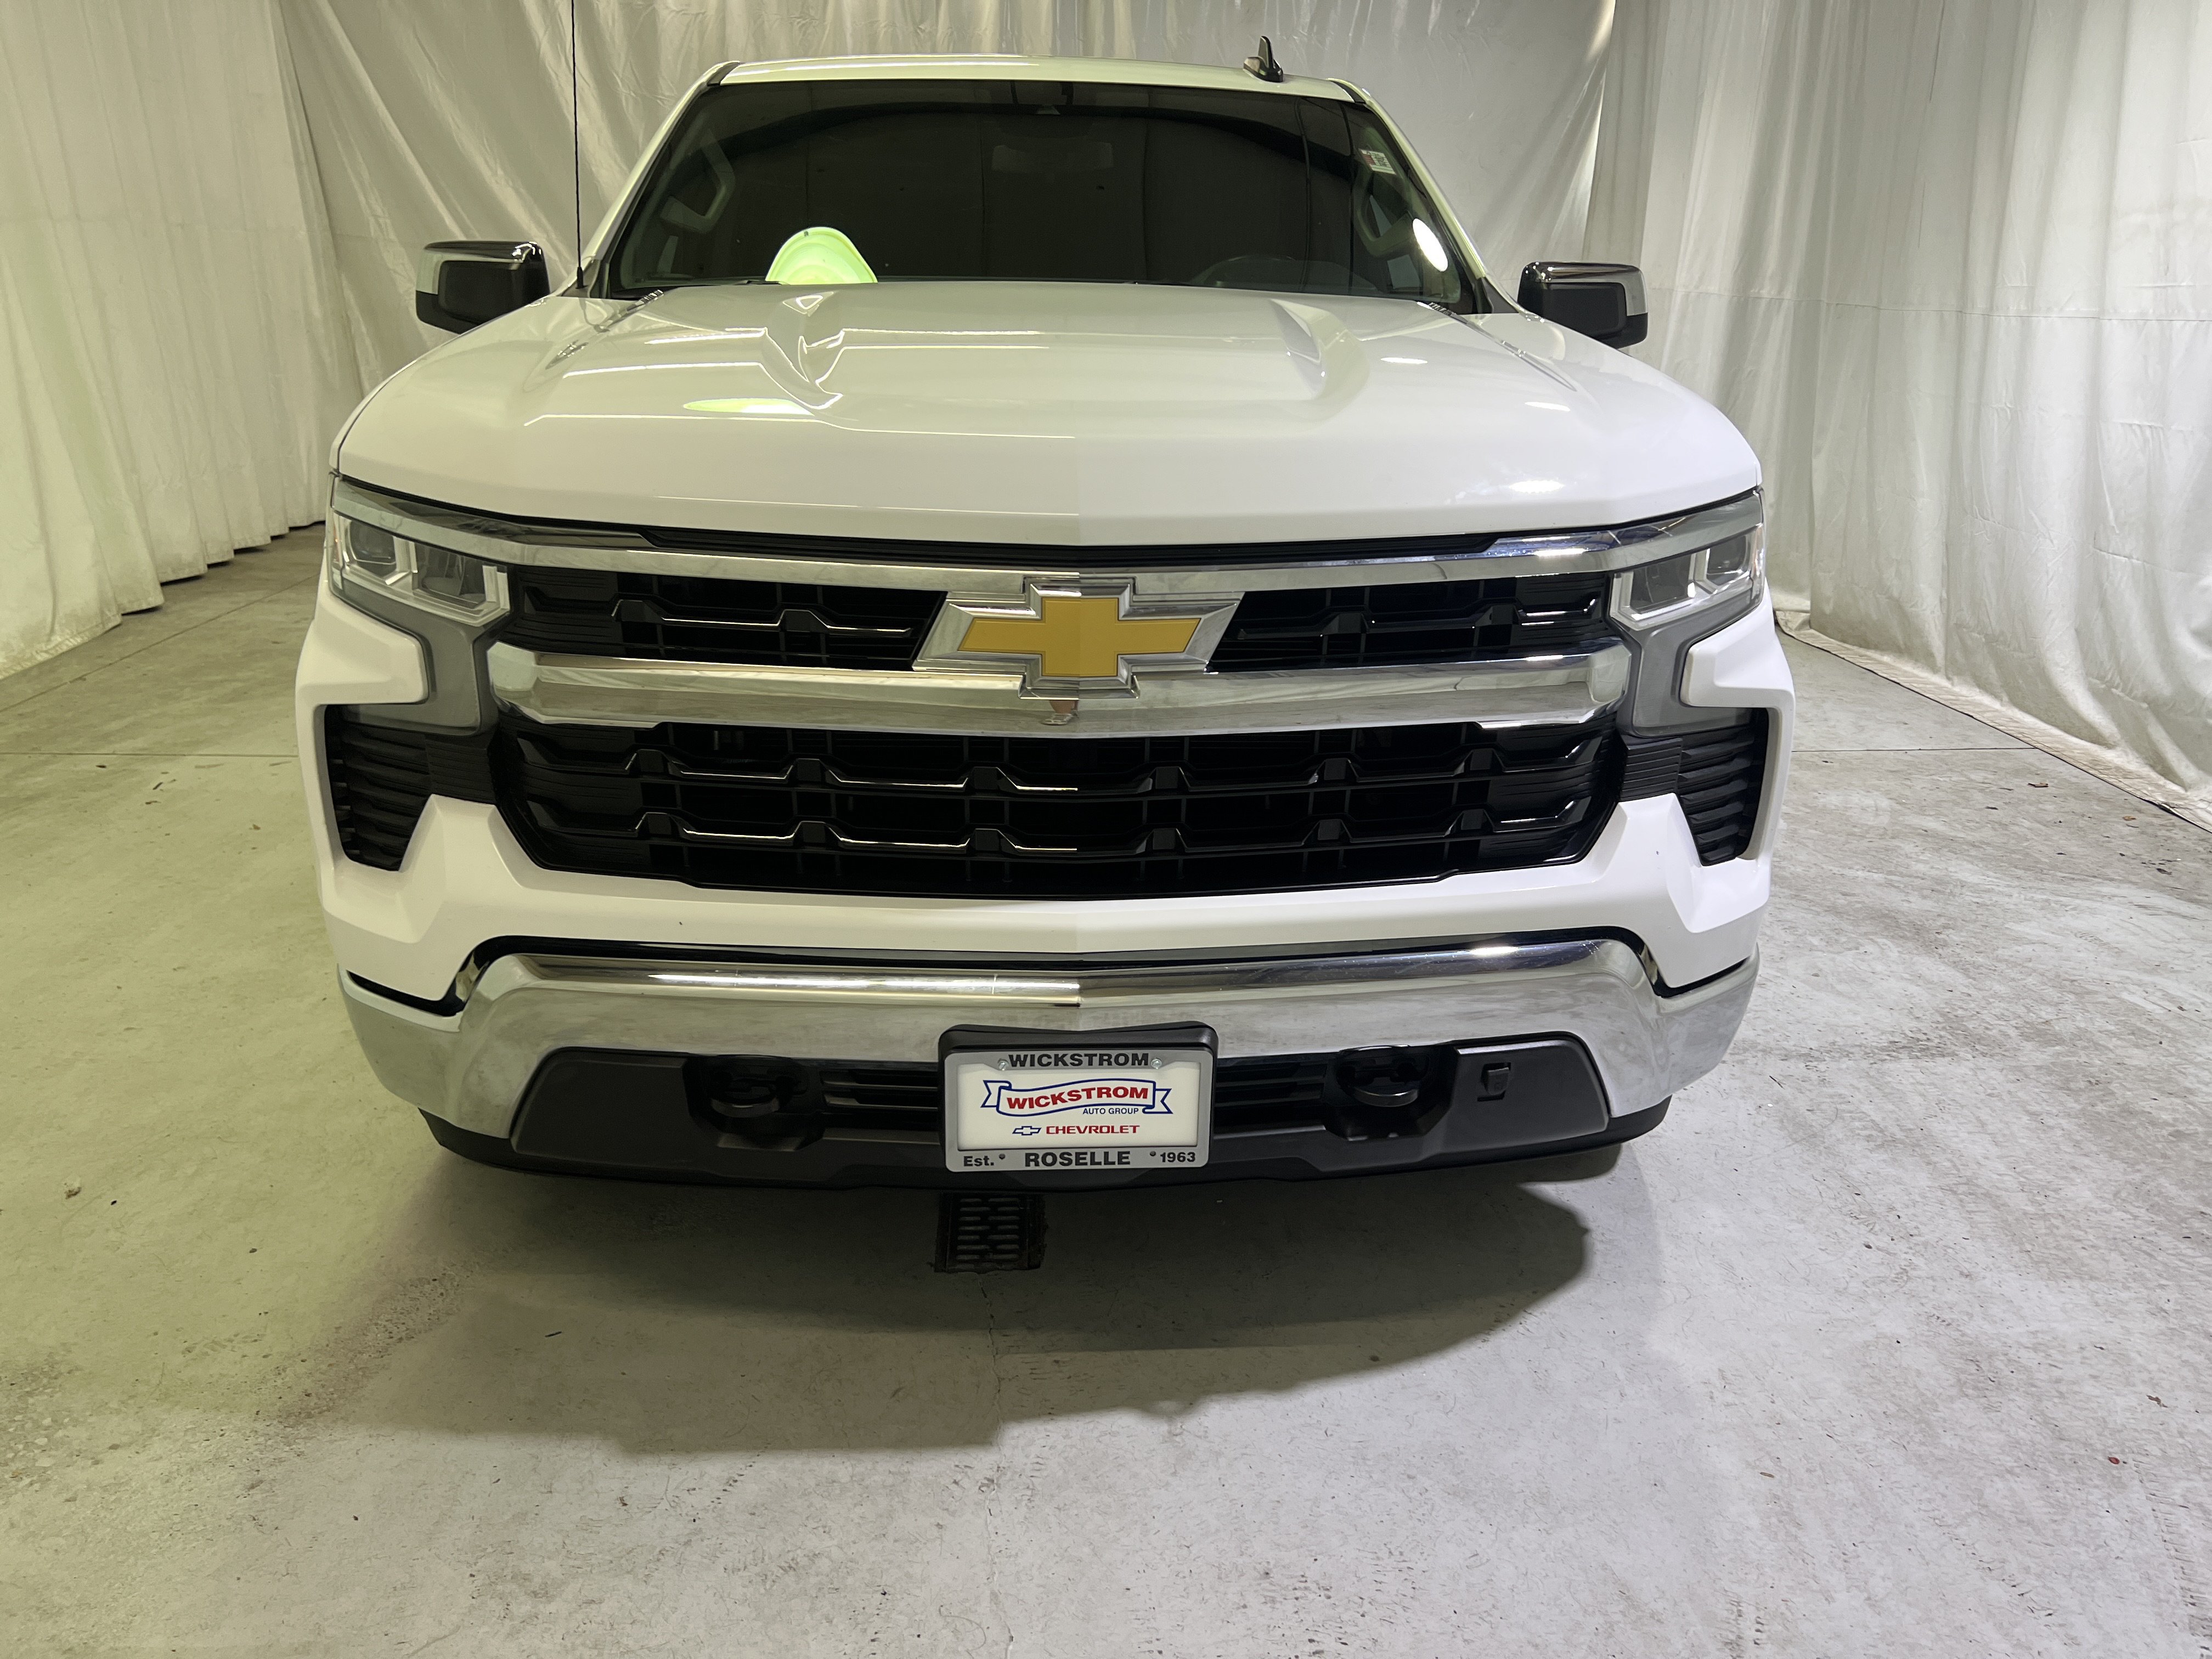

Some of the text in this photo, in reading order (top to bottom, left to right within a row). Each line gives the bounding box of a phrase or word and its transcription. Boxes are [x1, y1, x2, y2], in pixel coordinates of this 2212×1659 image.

[1008, 1053, 1149, 1068] WICKSTROM
[1007, 1087, 1149, 1109] WICKSTROM
[1046, 1125, 1140, 1135] CHEVROLET
[963, 1151, 1196, 1167] Est. ROSELLE 1963
